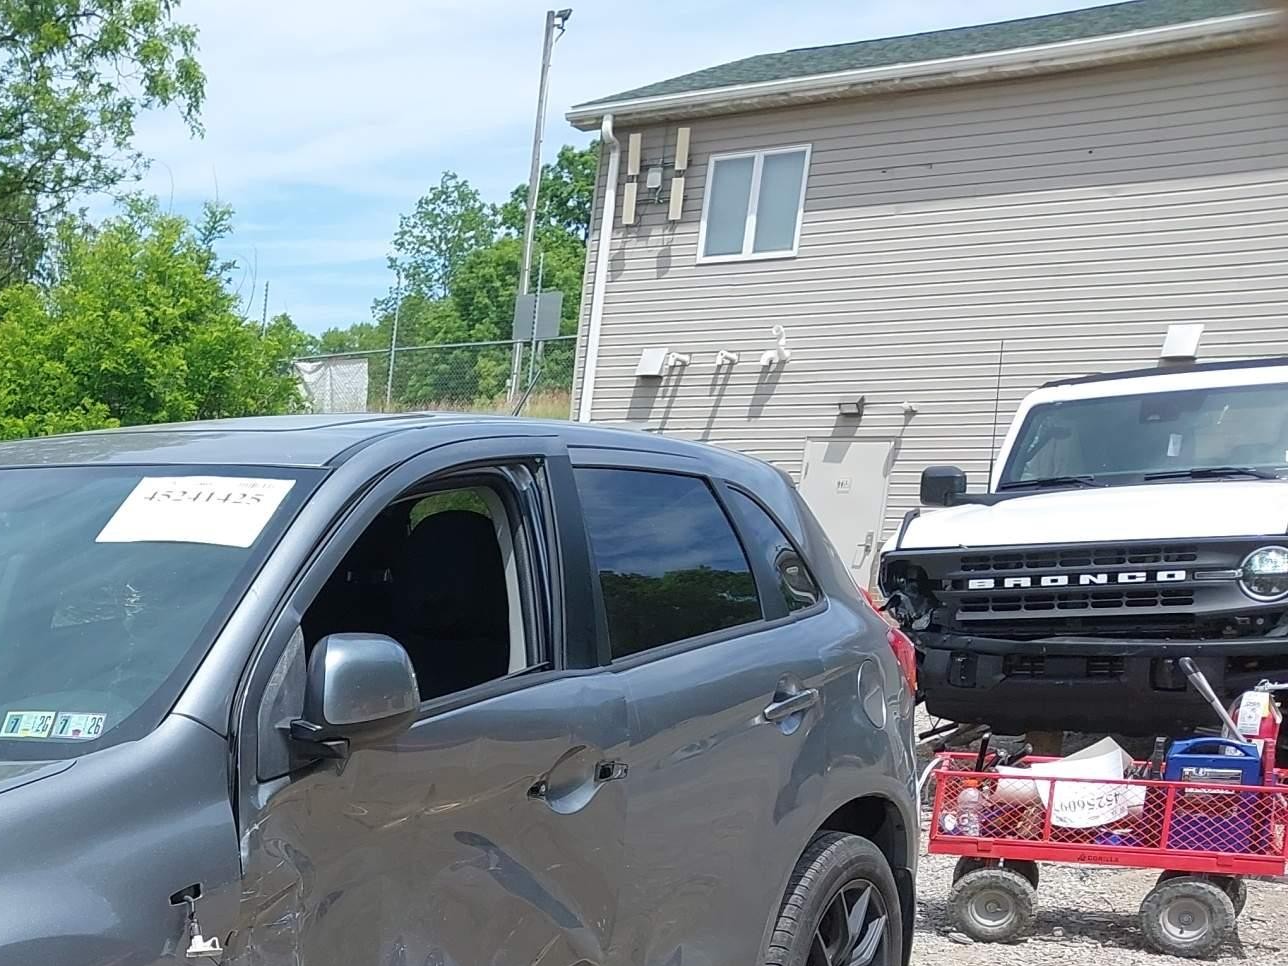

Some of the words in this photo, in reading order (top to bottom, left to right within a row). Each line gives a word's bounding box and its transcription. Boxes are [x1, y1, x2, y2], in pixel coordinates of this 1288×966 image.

[143, 490, 265, 505] 45241425
[968, 570, 1186, 590] BRONCO
[10, 718, 20, 734] 7
[58, 718, 69, 735] 7
[87, 716, 103, 735] 26
